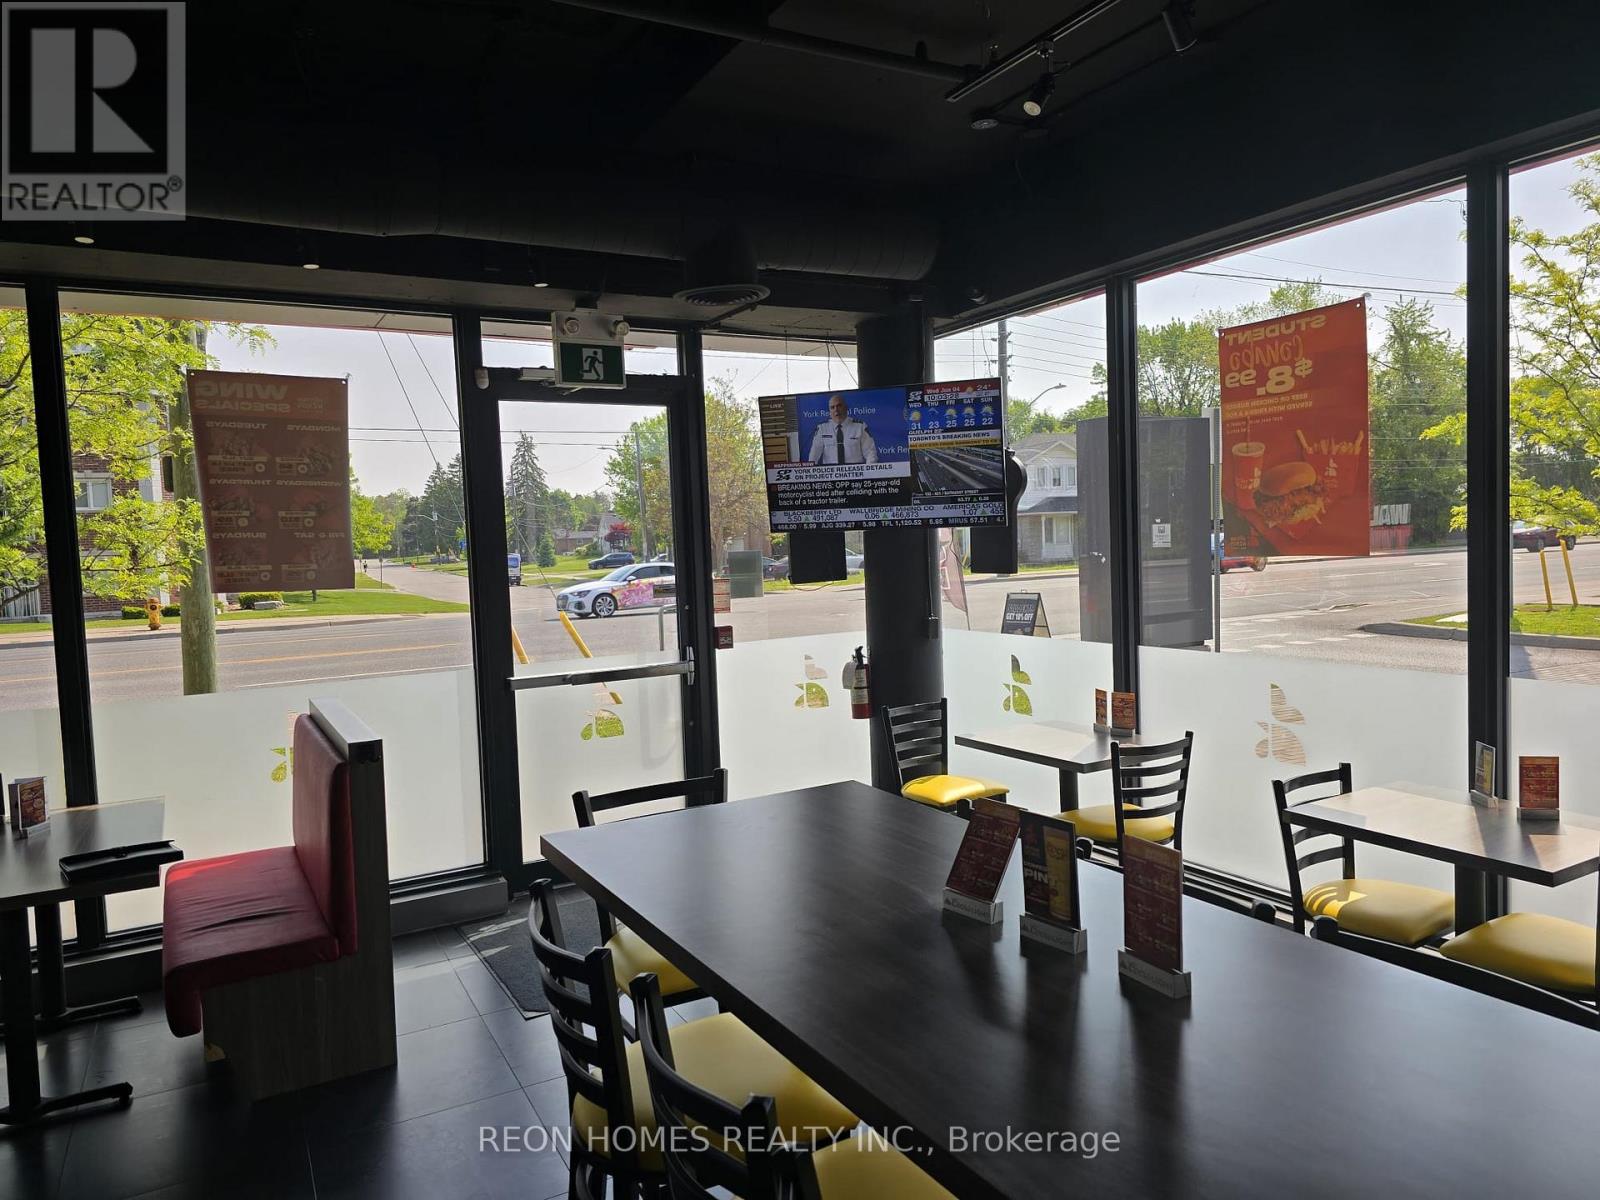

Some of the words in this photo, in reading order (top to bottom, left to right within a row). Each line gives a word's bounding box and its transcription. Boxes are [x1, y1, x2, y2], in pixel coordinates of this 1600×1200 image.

[803, 410, 818, 418] York
[854, 406, 876, 414] Police
[946, 420, 957, 428] 25
[878, 447, 895, 455] York
[777, 483, 811, 491] BREAKING
[812, 482, 834, 490] NEWS:
[851, 481, 862, 489] say
[863, 479, 901, 487] 25-year-old
[778, 491, 815, 500] motorcyclist
[846, 488, 872, 497] colliding
[778, 498, 794, 506] back
[807, 497, 829, 505] tractor
[829, 496, 849, 504] trailer.
[849, 507, 893, 515] WALLBRIDGE
[963, 508, 977, 516] 1.07
[1006, 612, 1015, 620] GET
[1024, 613, 1034, 621] OFF
[1024, 867, 1058, 886] PINT
